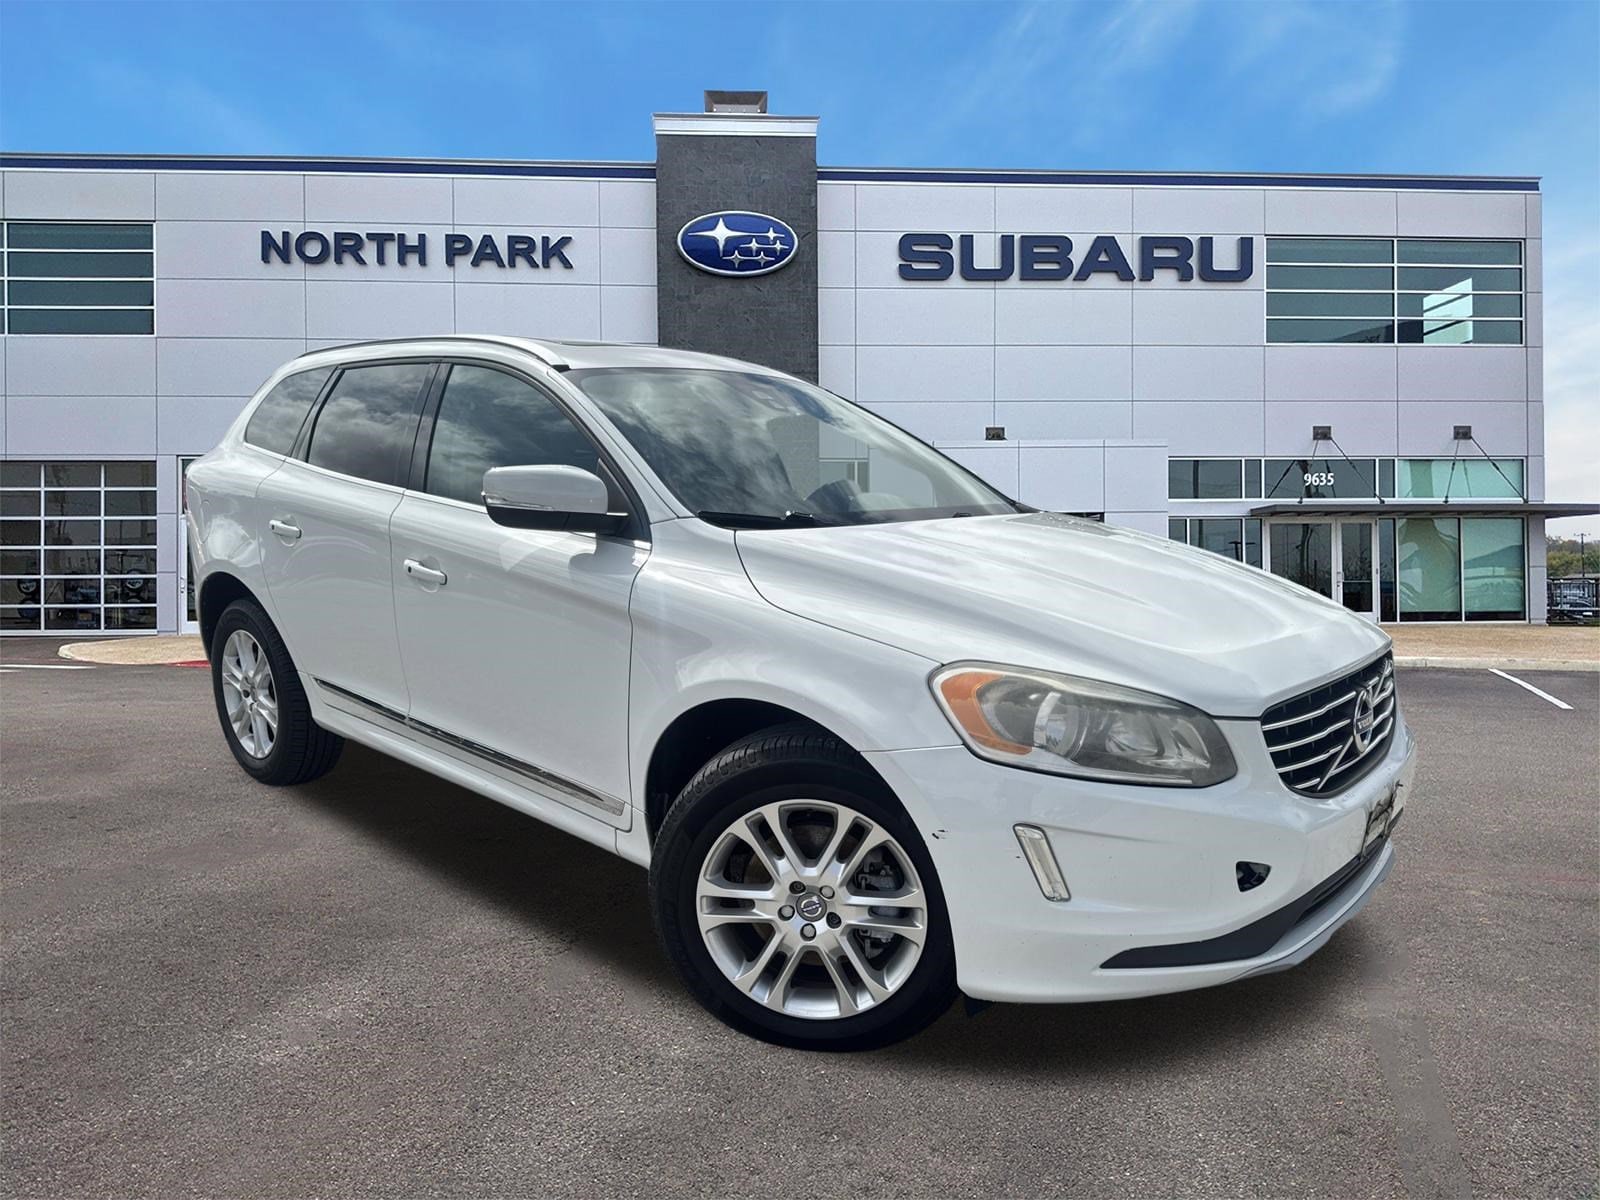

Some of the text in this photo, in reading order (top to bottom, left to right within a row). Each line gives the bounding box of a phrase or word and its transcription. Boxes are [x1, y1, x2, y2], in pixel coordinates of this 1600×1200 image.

[261, 230, 574, 270] NORTH PARK
[898, 232, 1254, 282] SUBARU
[1303, 472, 1335, 486] 9635
